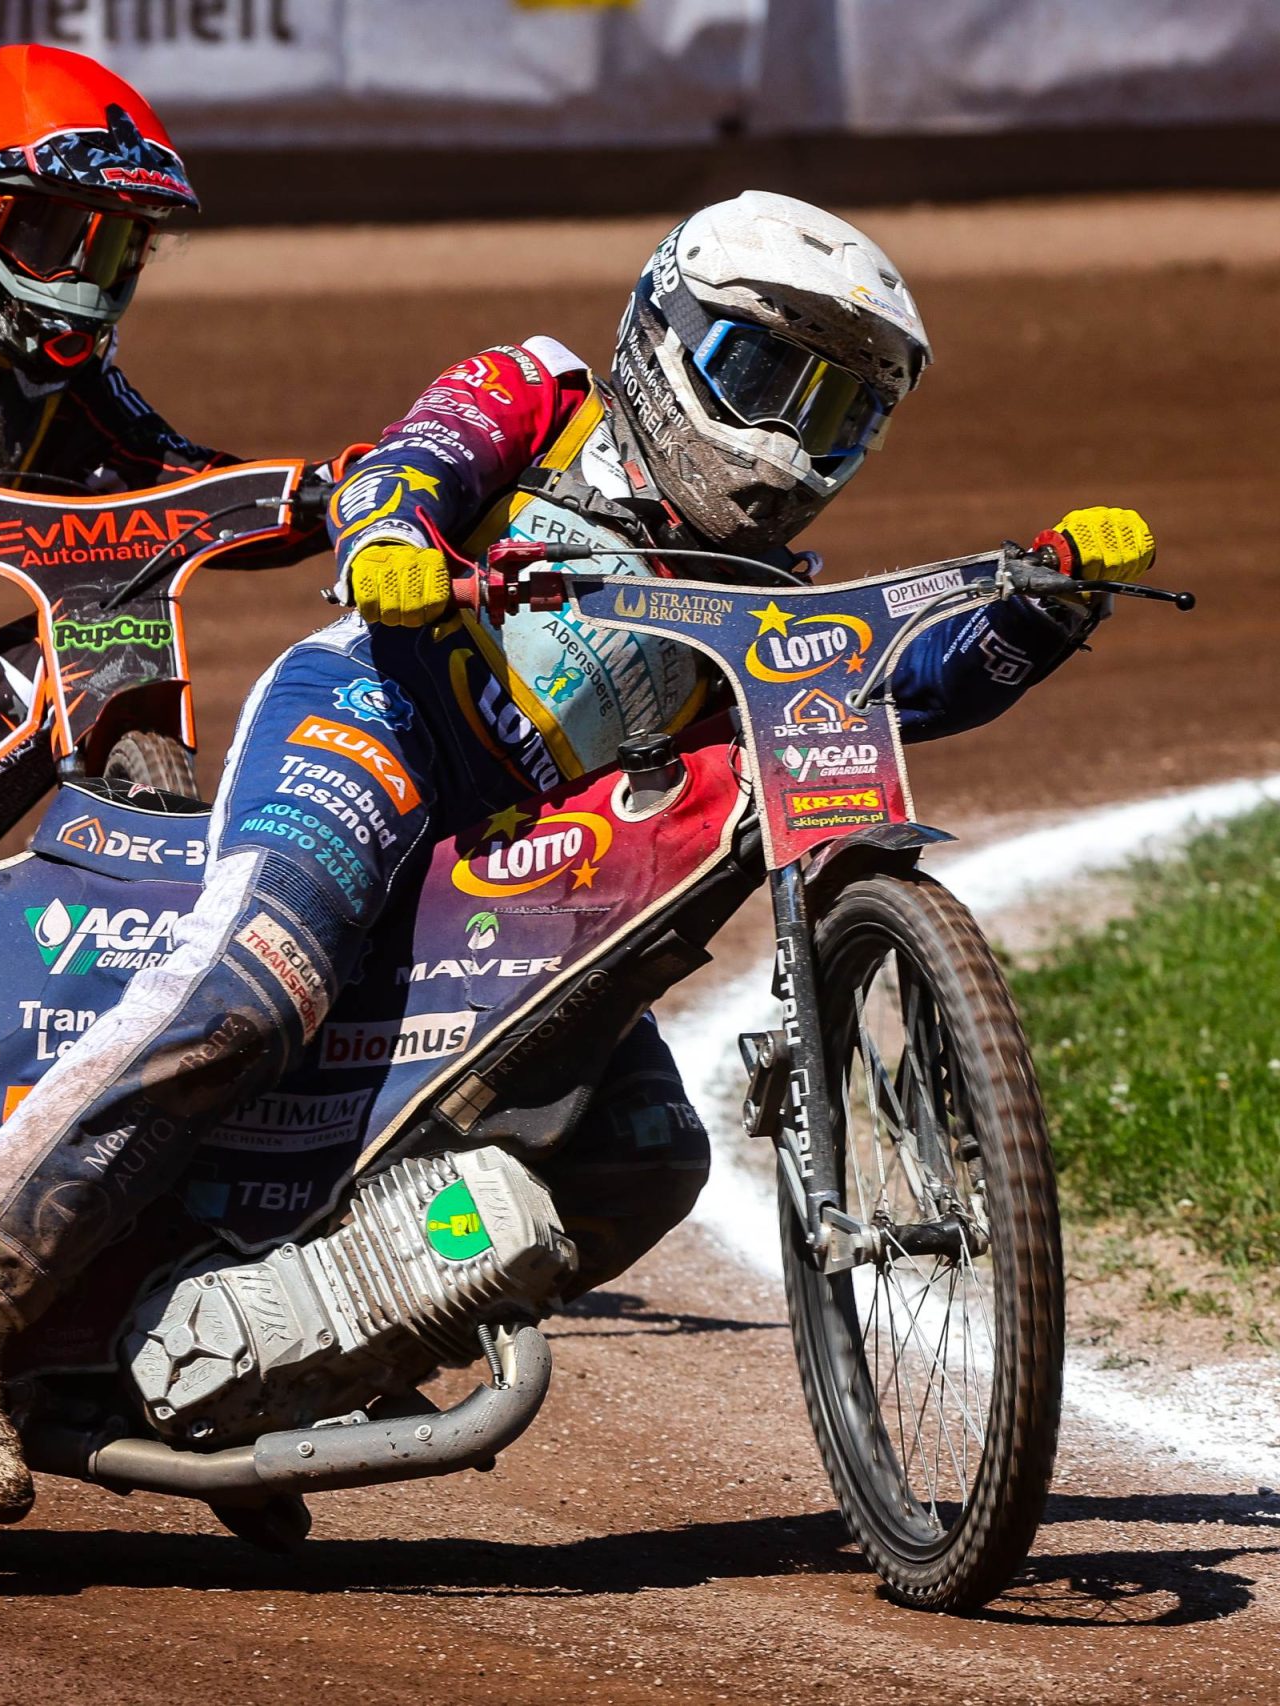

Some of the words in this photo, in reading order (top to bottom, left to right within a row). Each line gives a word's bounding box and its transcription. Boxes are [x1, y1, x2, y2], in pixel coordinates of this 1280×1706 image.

[21, 541, 187, 569] Automation
[649, 591, 734, 614] STRATTON
[887, 573, 961, 604] OPTIMUM
[649, 604, 724, 626] BROKERS
[54, 617, 174, 652] PapCup
[768, 626, 849, 671] LOTTO
[542, 619, 615, 717] Abensberg
[303, 725, 407, 801] KUKA
[800, 744, 879, 774] AGAD
[820, 764, 878, 777] GWARDIAK
[276, 775, 371, 845] Leszno
[279, 755, 398, 850] Transbud
[792, 789, 879, 813] KRZYŚ
[240, 818, 316, 850] MIASTO
[793, 812, 884, 827] sklepykrzys.pl
[261, 803, 371, 890] KOŁOBRZEG
[486, 826, 584, 880] LOTTO
[60, 907, 180, 962] AGA
[246, 930, 318, 1035] TRANSPORT
[395, 955, 563, 986] MAVER
[19, 1001, 98, 1032] Tran
[326, 1023, 468, 1064] biomus
[235, 1094, 361, 1127] PTIMUM
[236, 1180, 315, 1213] TBH
